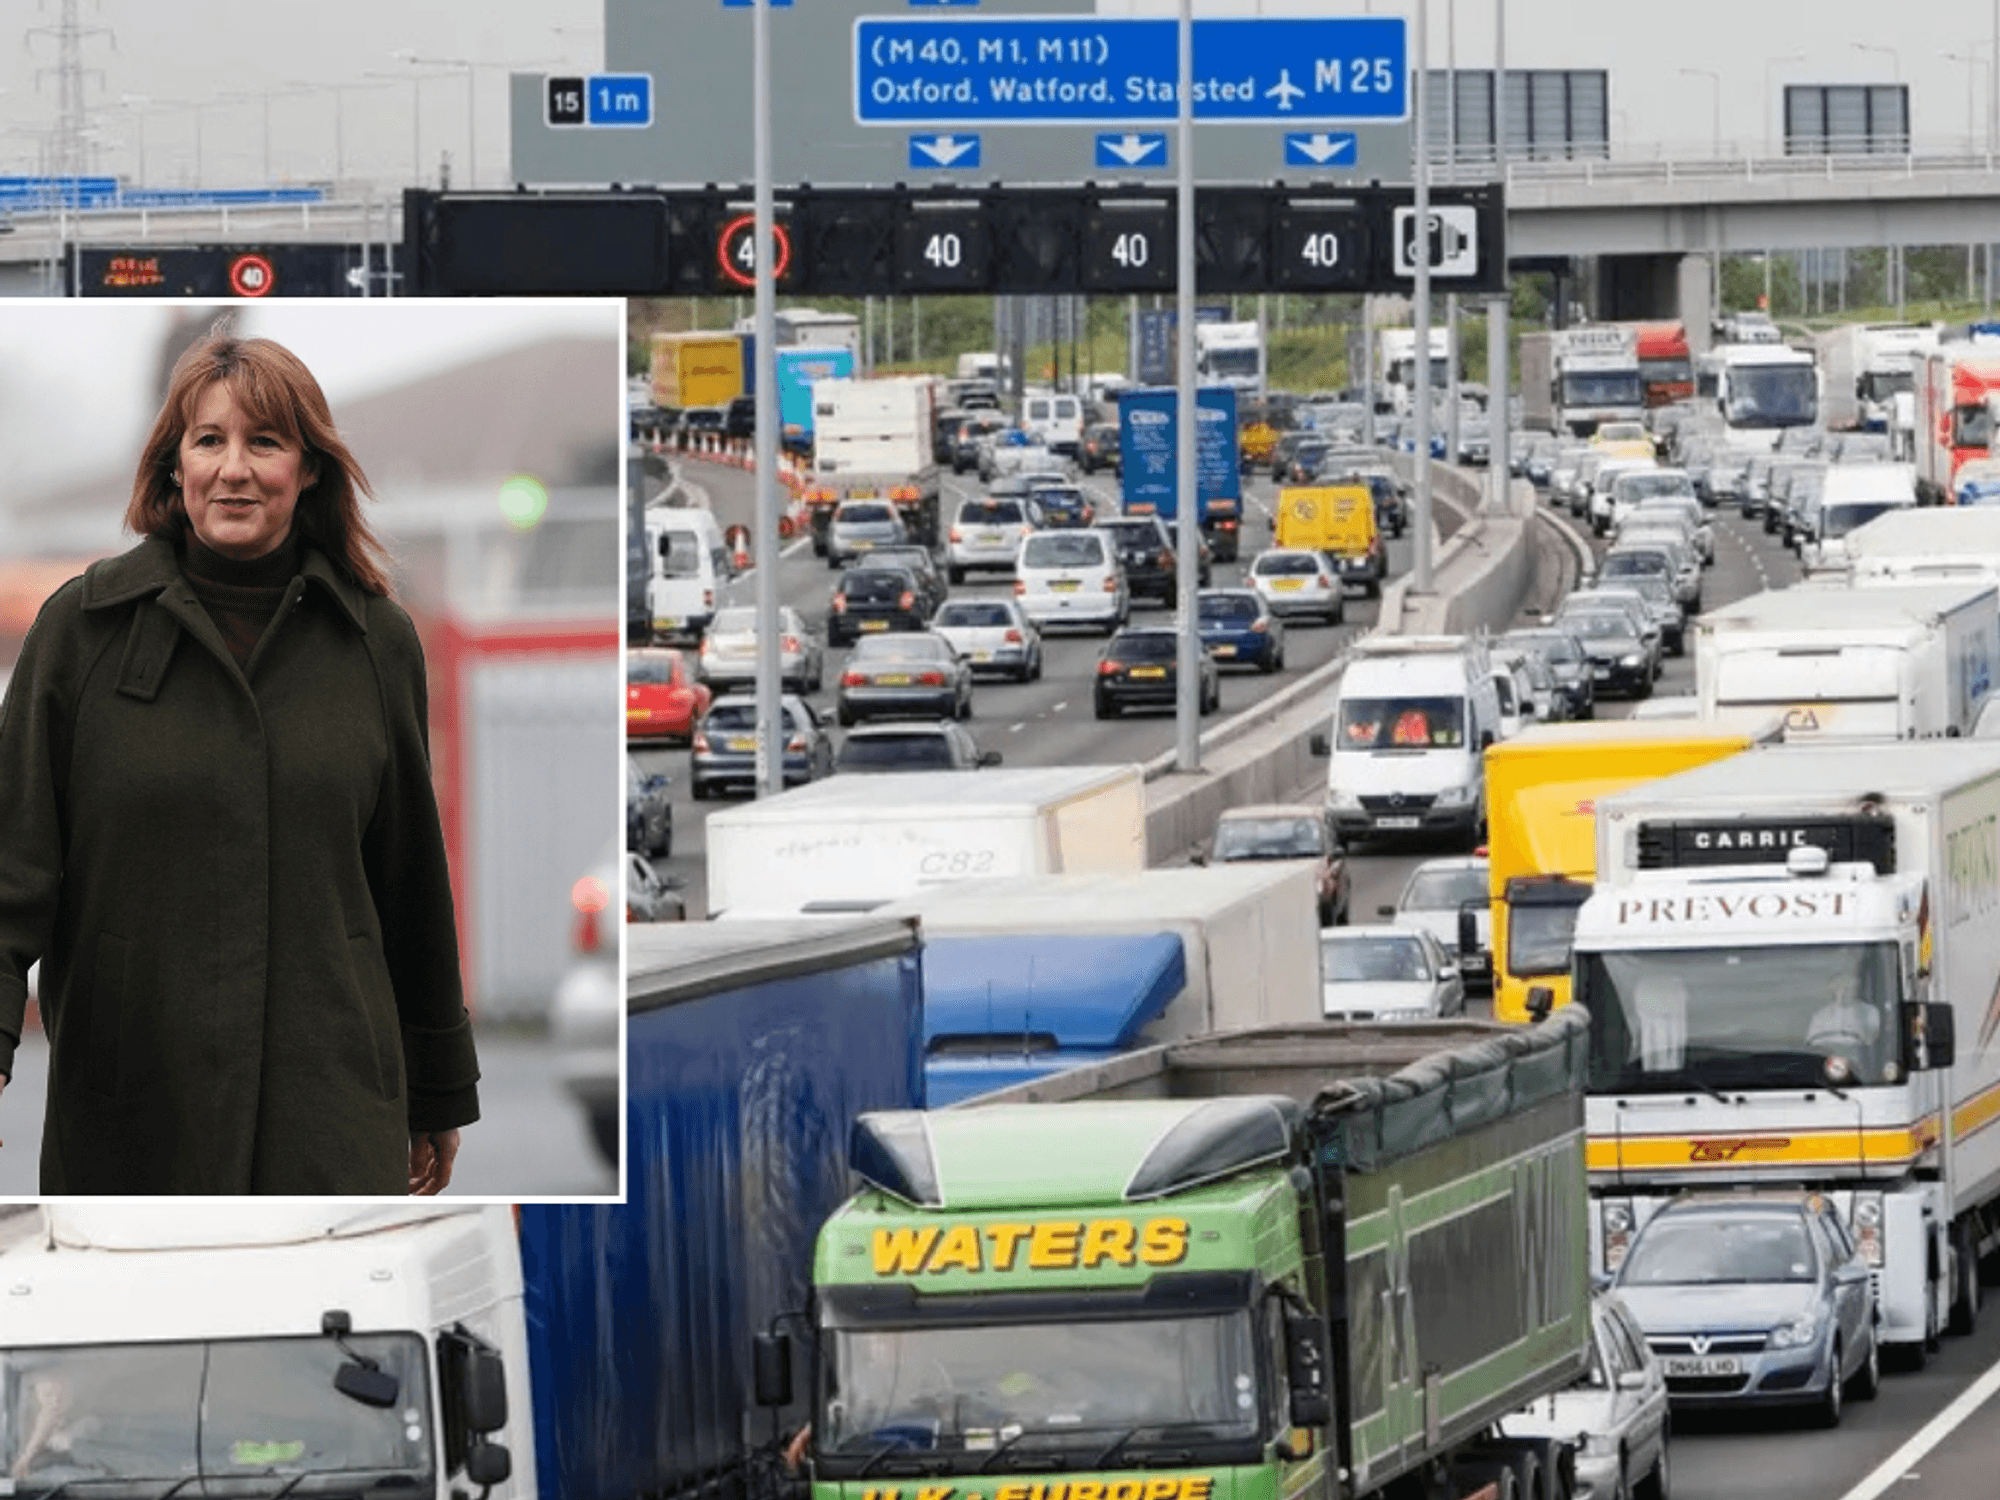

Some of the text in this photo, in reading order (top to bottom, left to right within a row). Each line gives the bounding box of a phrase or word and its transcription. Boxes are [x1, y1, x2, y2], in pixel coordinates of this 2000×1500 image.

[554, 91, 580, 113] 15
[924, 233, 962, 268] 40
[1111, 233, 1149, 268] 40
[1301, 233, 1339, 268] 40
[241, 266, 265, 288] 40
[1617, 893, 1857, 924] PREVOST
[872, 1218, 1192, 1274] WATERS
